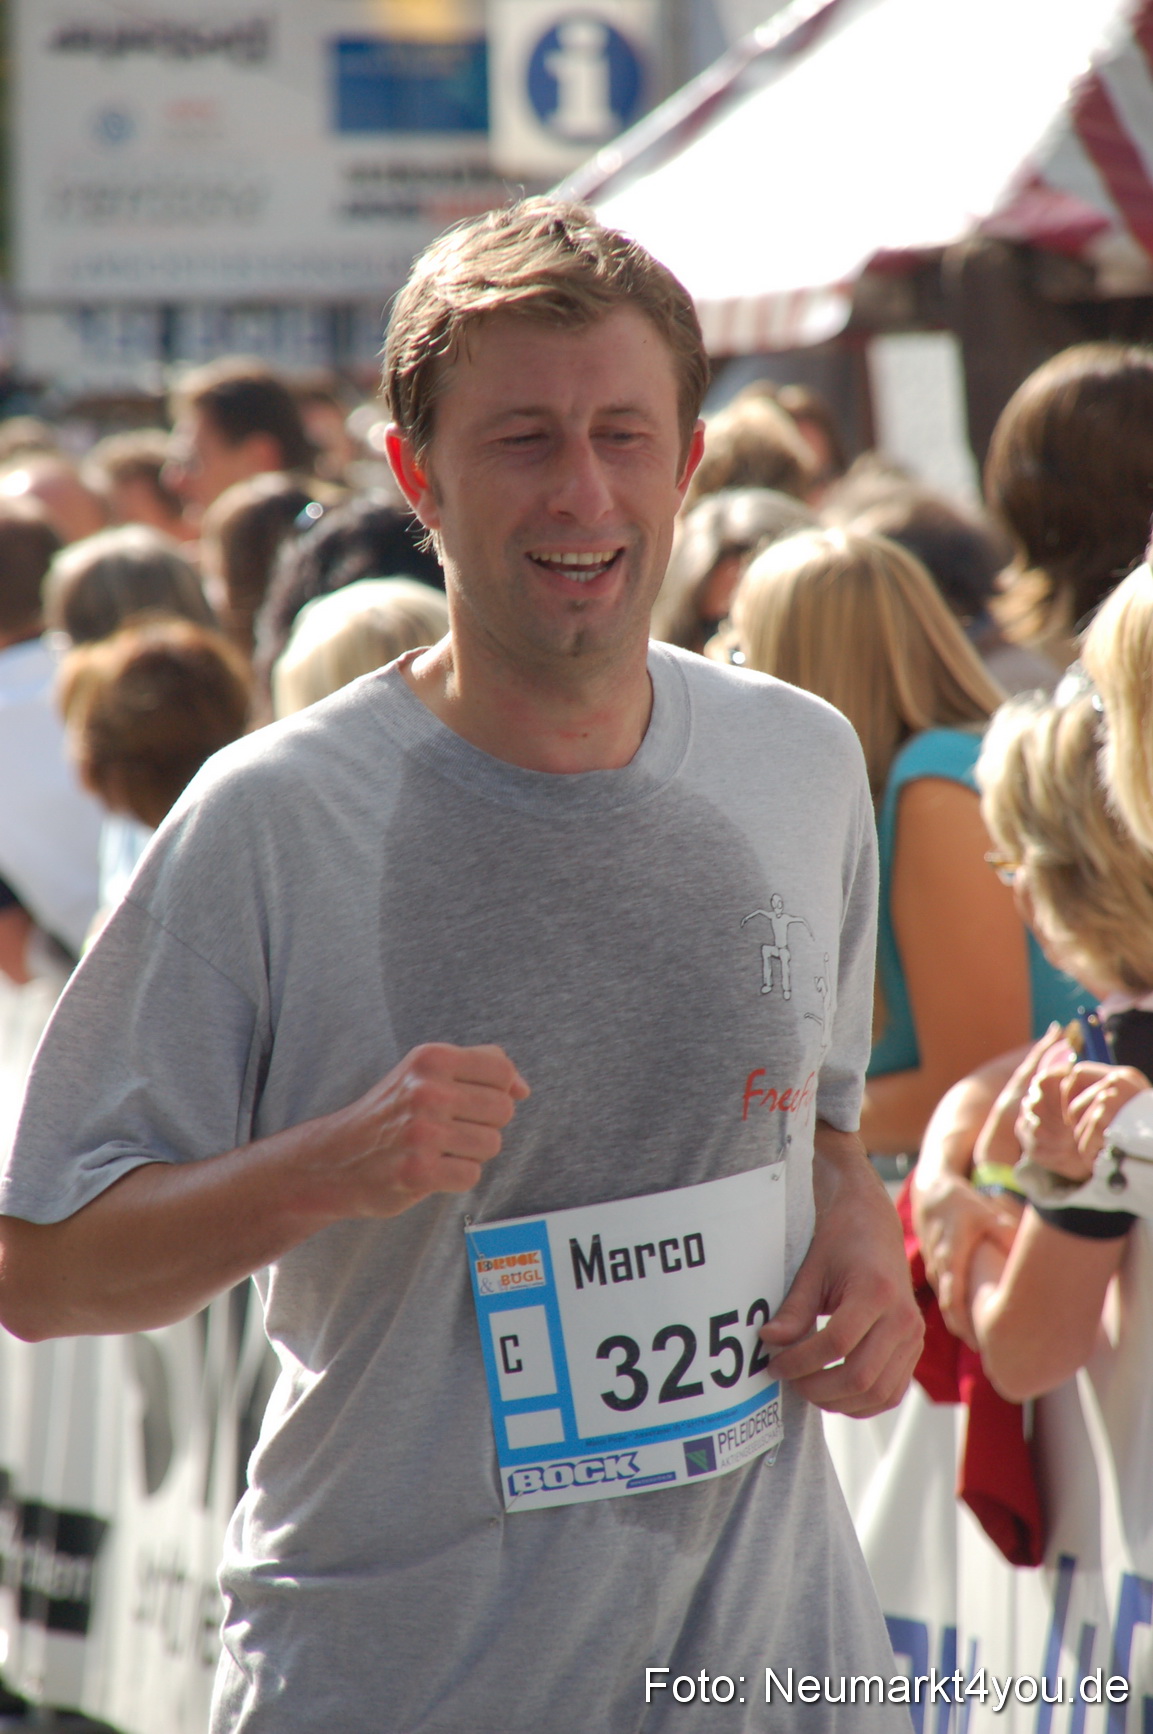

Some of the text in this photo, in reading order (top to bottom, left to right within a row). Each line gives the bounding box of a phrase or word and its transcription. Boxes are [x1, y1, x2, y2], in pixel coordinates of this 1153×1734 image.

[501, 1269, 543, 1287] BÜGL
[569, 1232, 706, 1290] Marco
[499, 1334, 523, 1374] C
[595, 1298, 770, 1412] 3252
[717, 1401, 781, 1455] PFLEIDERER
[507, 1451, 641, 1497] BOCK
